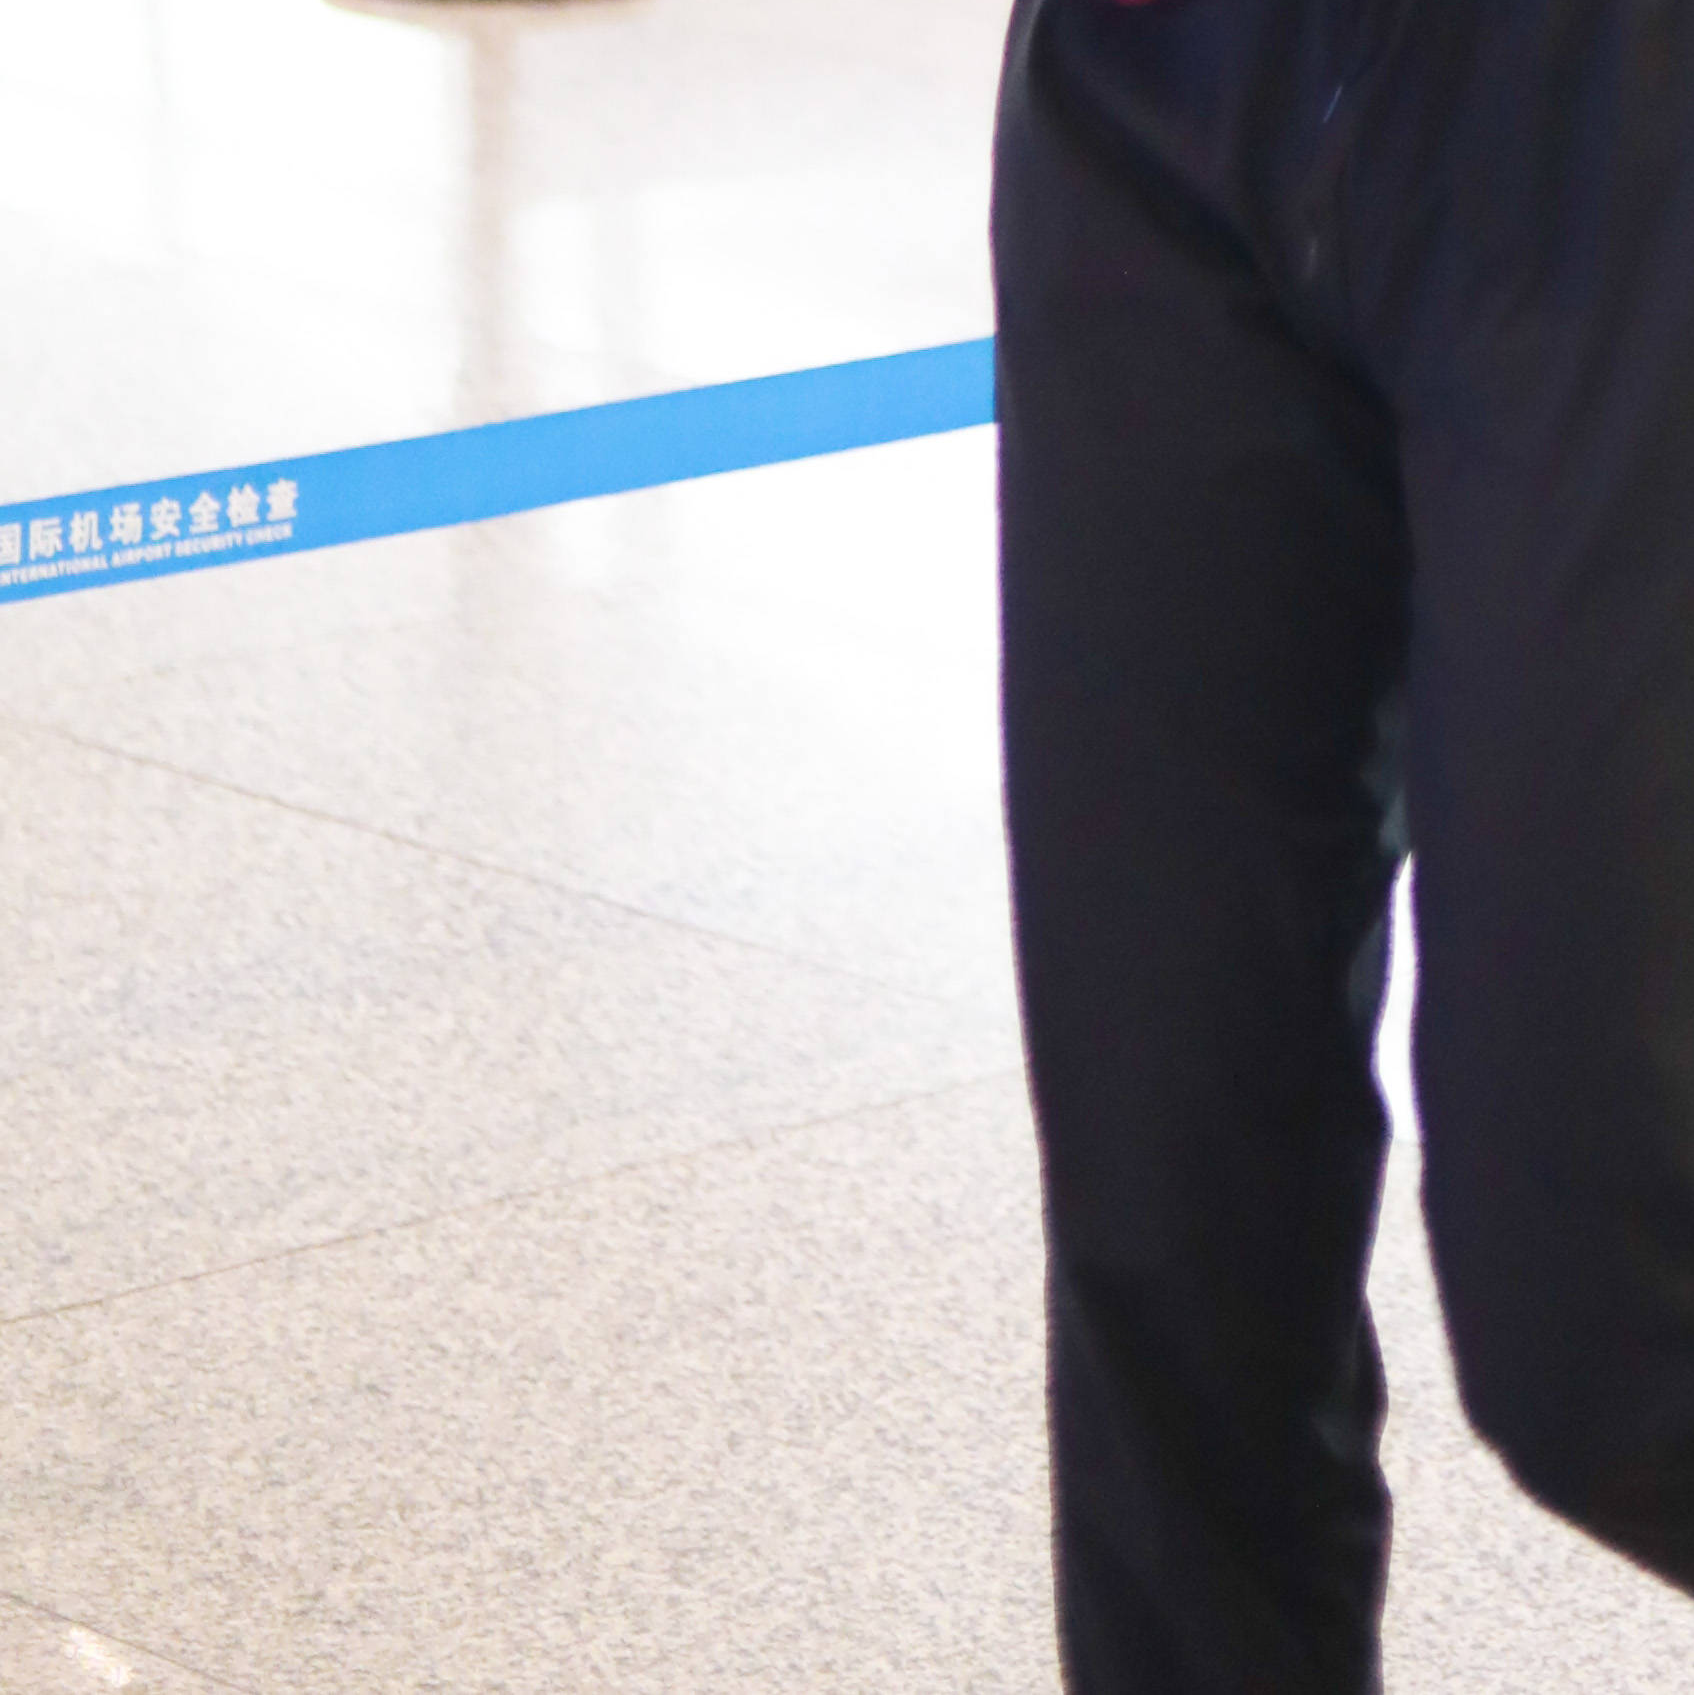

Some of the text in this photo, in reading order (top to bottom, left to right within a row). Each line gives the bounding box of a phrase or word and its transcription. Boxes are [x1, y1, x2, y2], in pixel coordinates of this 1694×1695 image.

[111, 542, 172, 568] AIRPORT
[174, 531, 243, 557] SECURITY
[245, 522, 293, 546] CHECK
